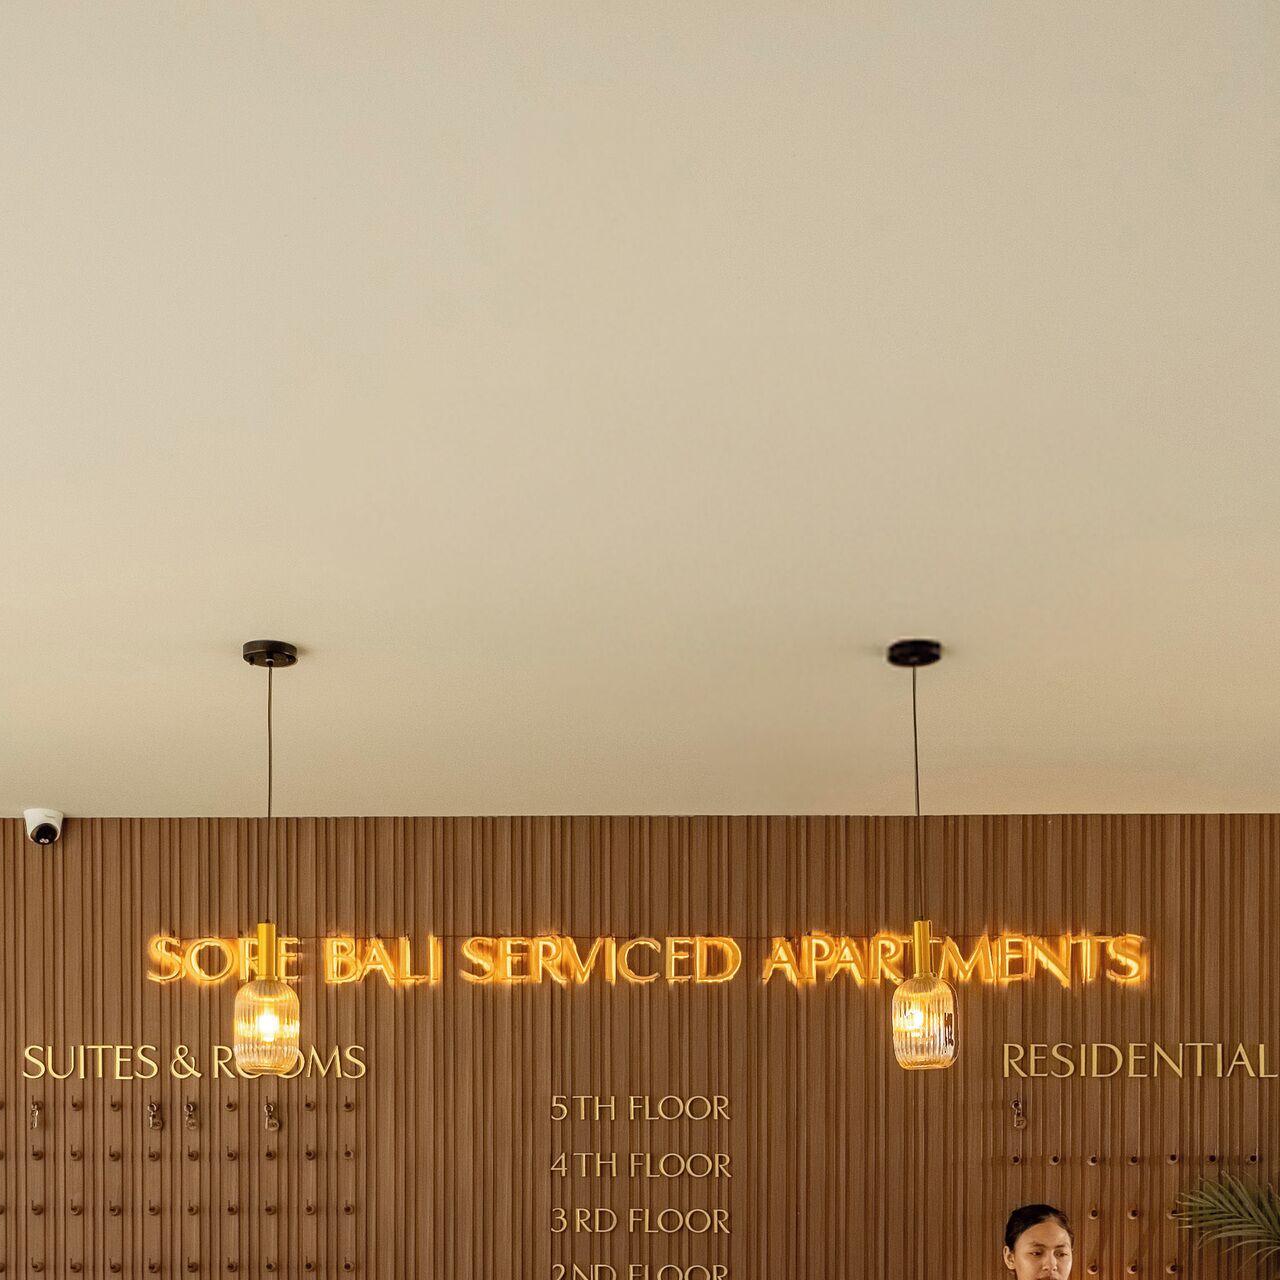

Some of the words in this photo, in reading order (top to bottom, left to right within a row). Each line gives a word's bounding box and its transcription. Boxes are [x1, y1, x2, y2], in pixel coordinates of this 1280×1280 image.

[324, 936, 441, 983] BALI
[460, 936, 742, 983] SERVICED
[22, 1044, 158, 1079] SUITES
[171, 1044, 202, 1079] &
[1003, 1042, 1279, 1078] RESIDENTIAL
[629, 1095, 731, 1121] FLOOR
[629, 1152, 731, 1178] FLOOR
[629, 1207, 731, 1233] FLOOR
